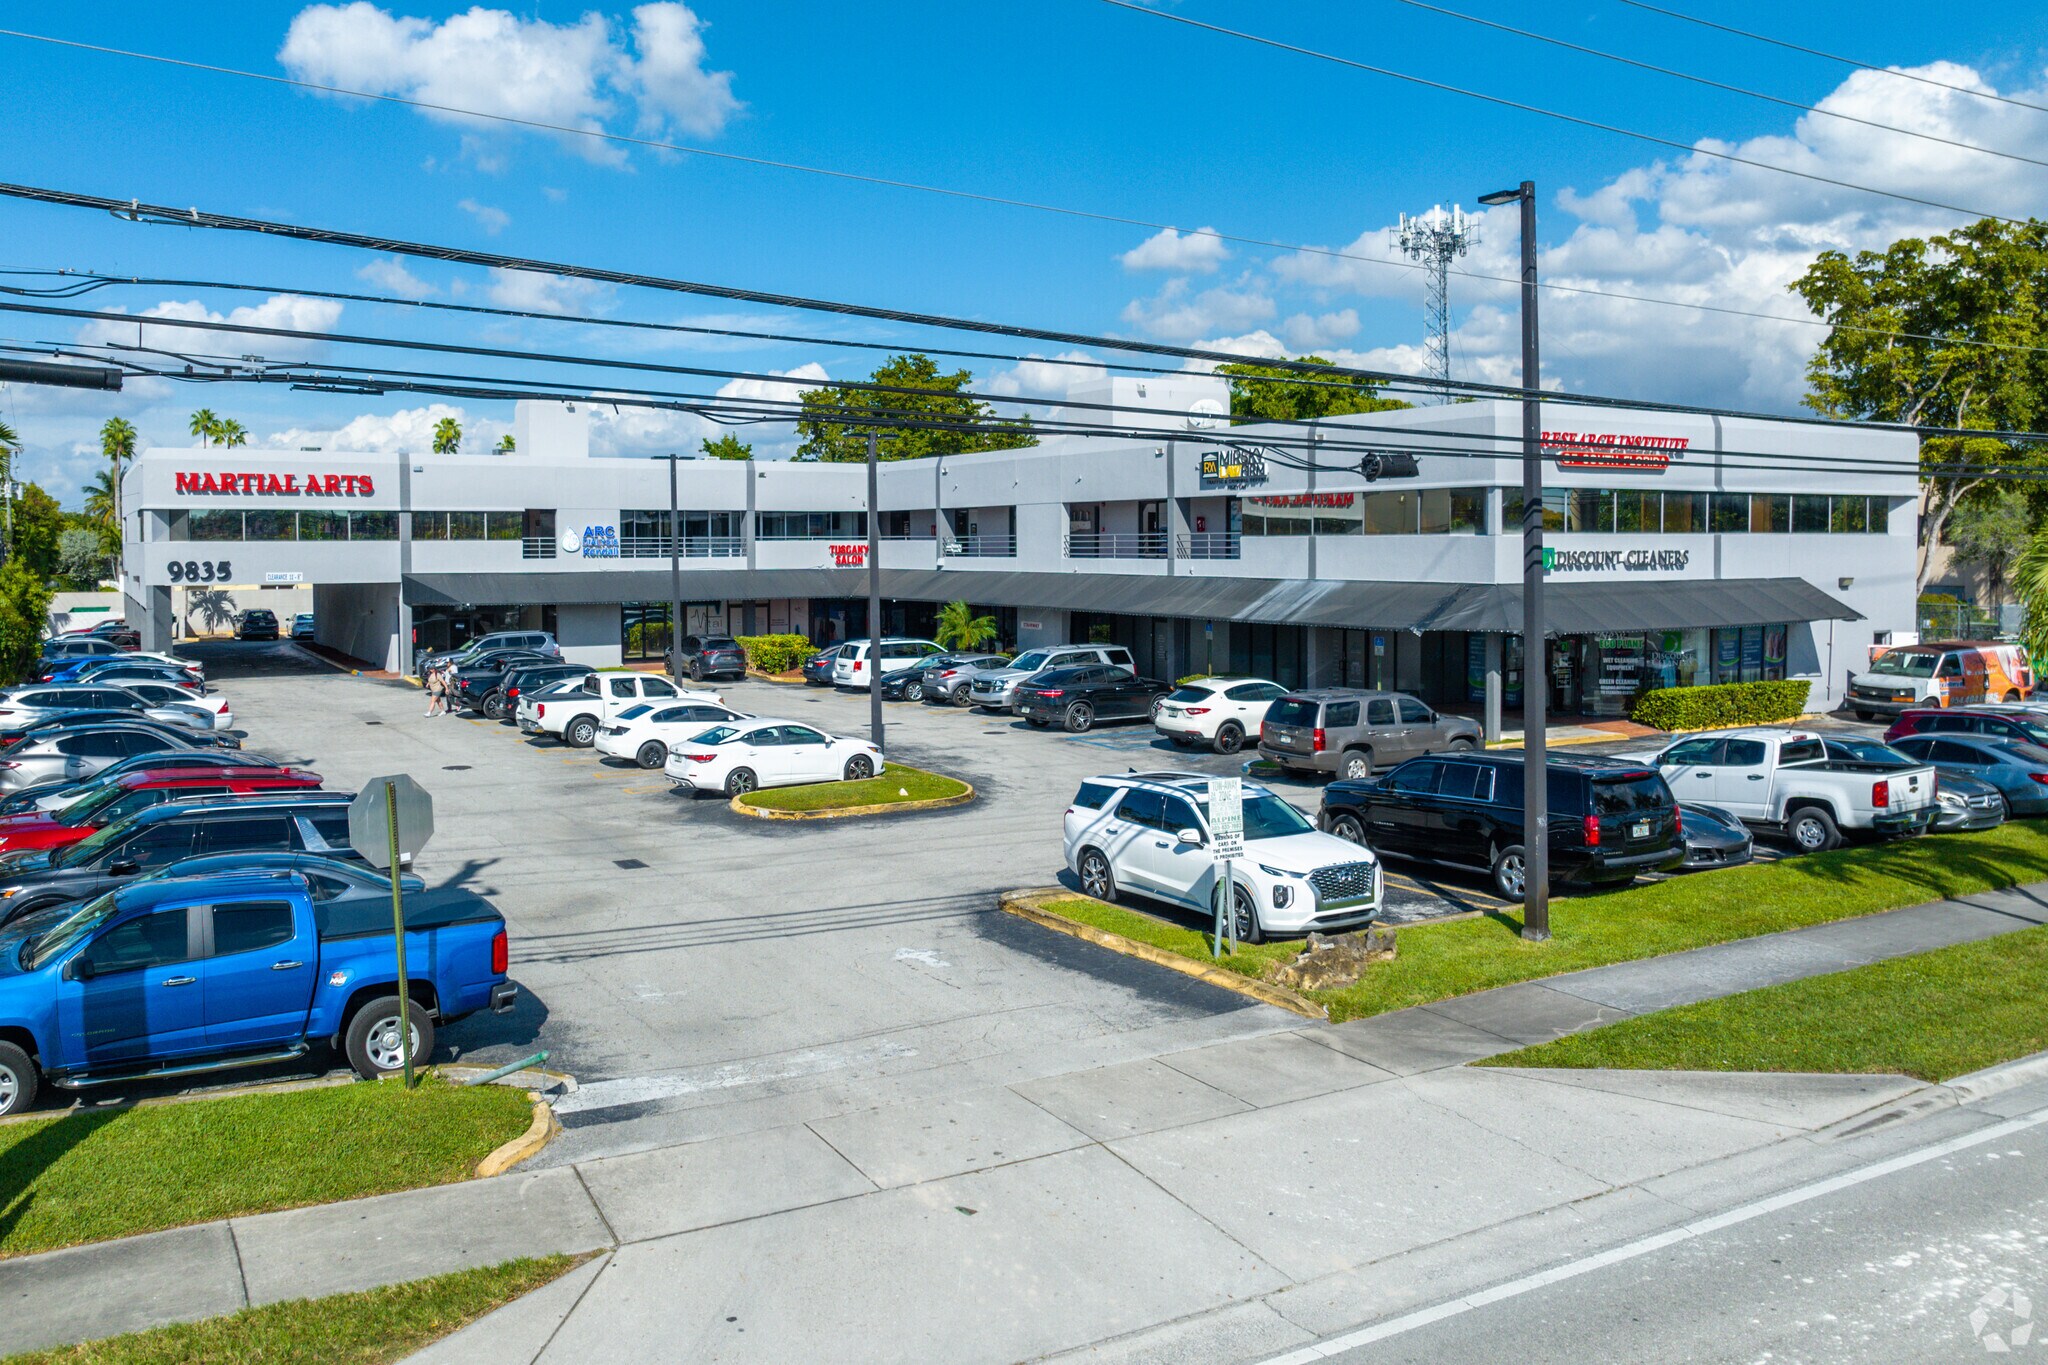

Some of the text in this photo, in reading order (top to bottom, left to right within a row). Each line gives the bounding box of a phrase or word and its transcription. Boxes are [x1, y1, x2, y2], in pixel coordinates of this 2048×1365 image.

[1540, 432, 1617, 449] RESEARCH
[1219, 447, 1265, 465] MIRSKY
[1218, 464, 1243, 478] LAW
[175, 472, 374, 494] MARTIAL ARTS
[584, 526, 615, 537] ARC
[583, 547, 619, 557] Kendall
[829, 545, 869, 555] TUSCANY
[835, 555, 864, 565] SALON
[1556, 550, 1689, 565] DISCOUNT CLEANERS
[167, 561, 232, 582] 9835
[1599, 639, 1643, 649] ECO PLANT
[1211, 815, 1242, 823] ALPINE
